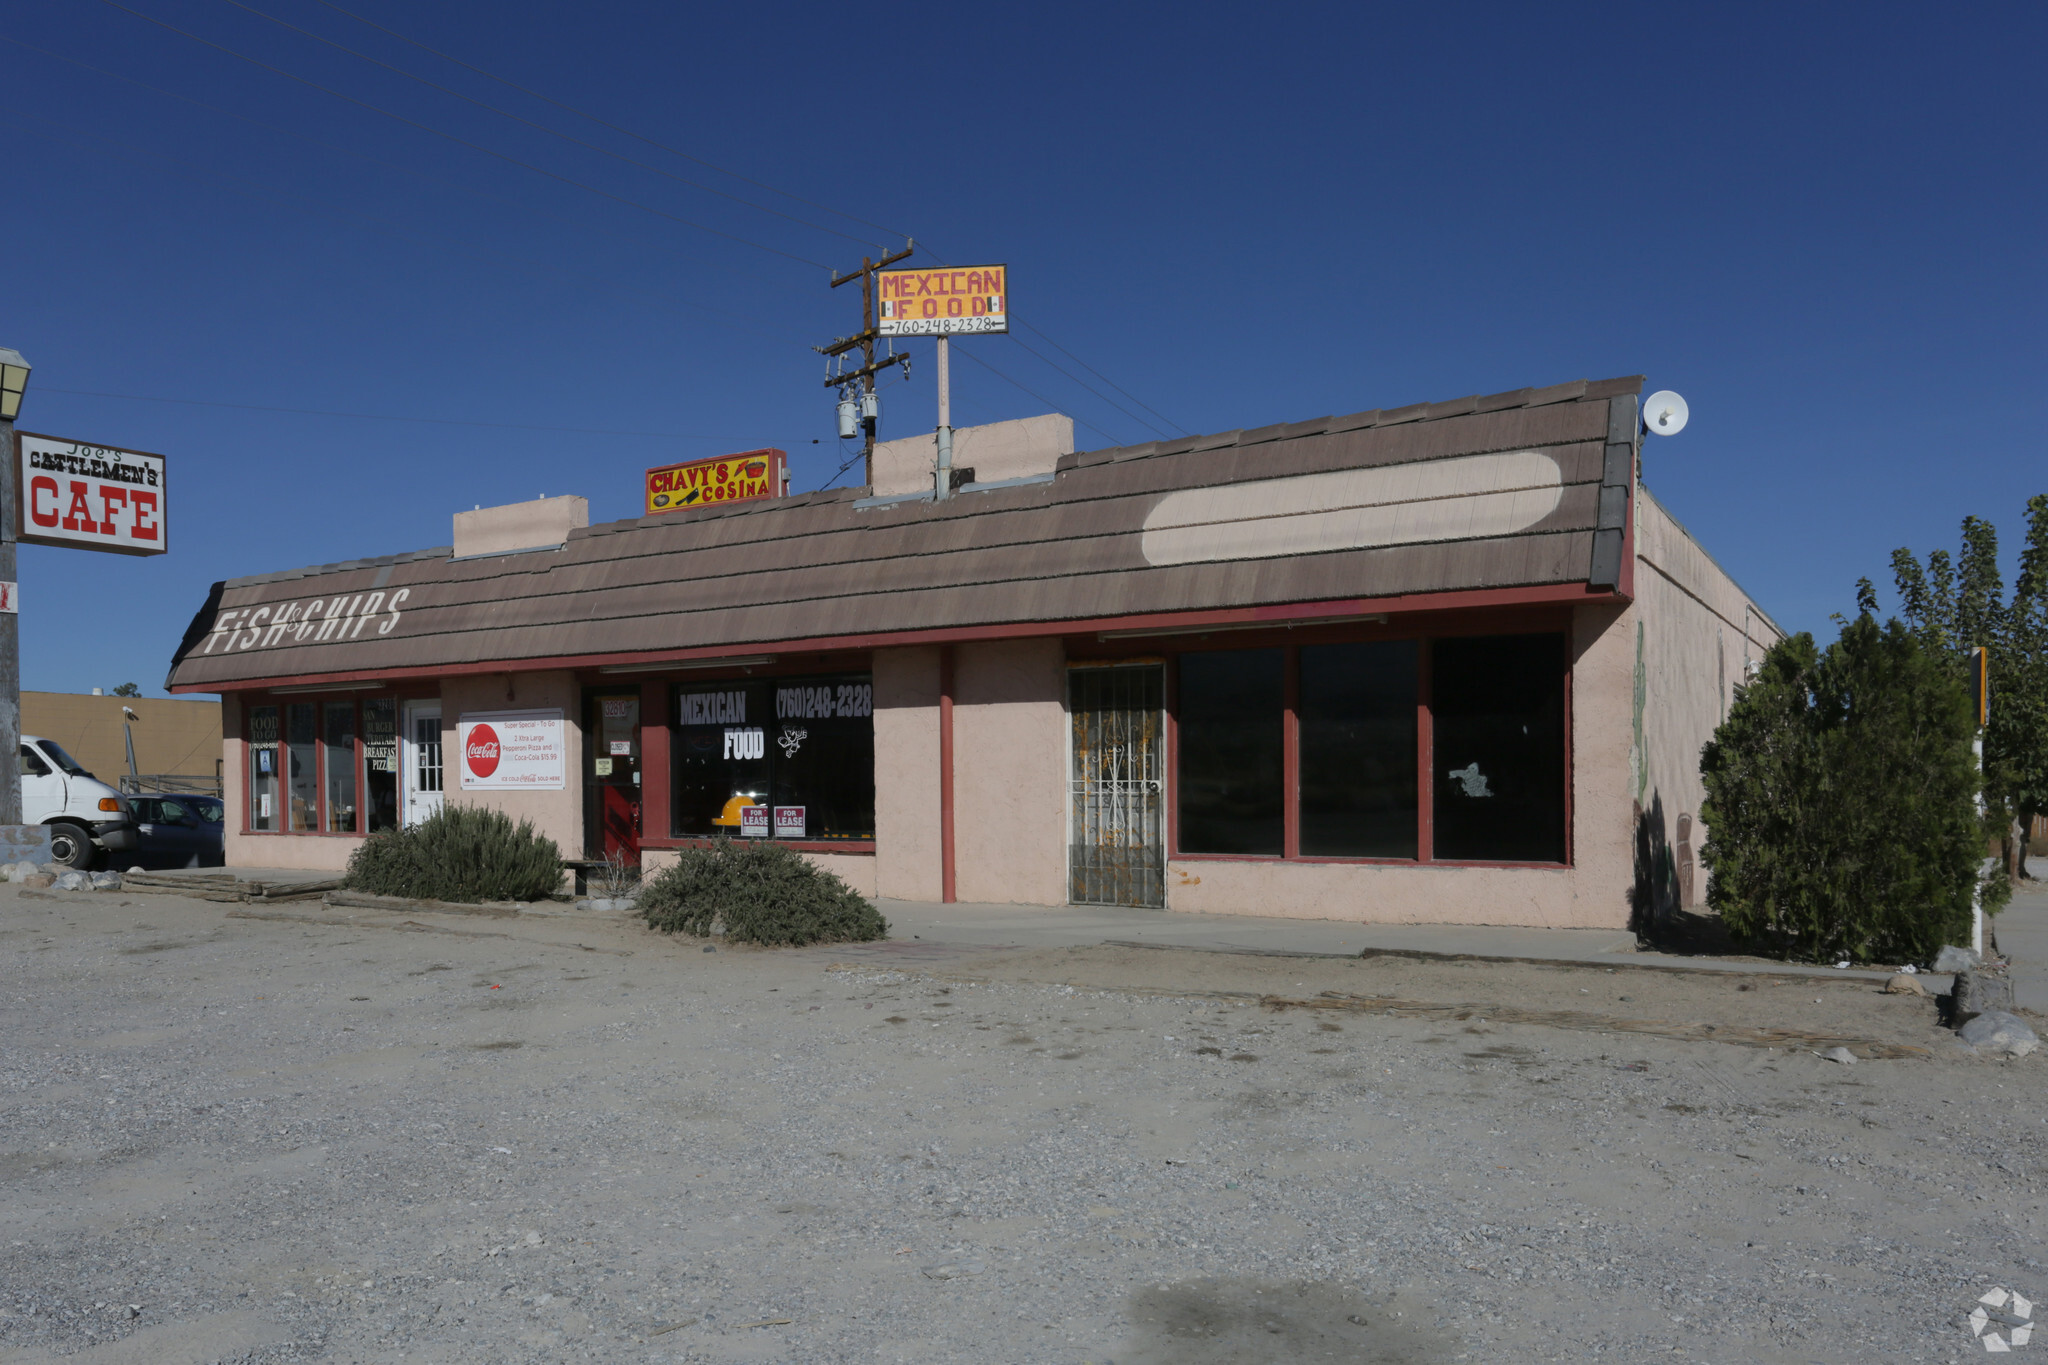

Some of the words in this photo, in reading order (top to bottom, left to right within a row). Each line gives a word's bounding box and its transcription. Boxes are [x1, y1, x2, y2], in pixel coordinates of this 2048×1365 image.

[882, 270, 1001, 298] MEXICAN
[897, 297, 987, 320] FOOD
[895, 318, 992, 334] 760-248-2328
[30, 451, 158, 487] CATTLEMEN'S
[650, 462, 730, 493] CHAVY'S
[703, 479, 769, 502] COSINA
[31, 475, 158, 541] CAFE
[286, 607, 302, 633] &
[294, 588, 411, 642] CHIPS
[605, 701, 626, 716] 32810
[680, 691, 746, 725] MEXICAN
[776, 685, 872, 719] (760)248-2328
[250, 716, 278, 730] FOOD
[723, 727, 764, 760] FOOD
[372, 759, 388, 770] PIZZ
[744, 816, 768, 825] LEASE
[777, 816, 803, 826] LEASE
